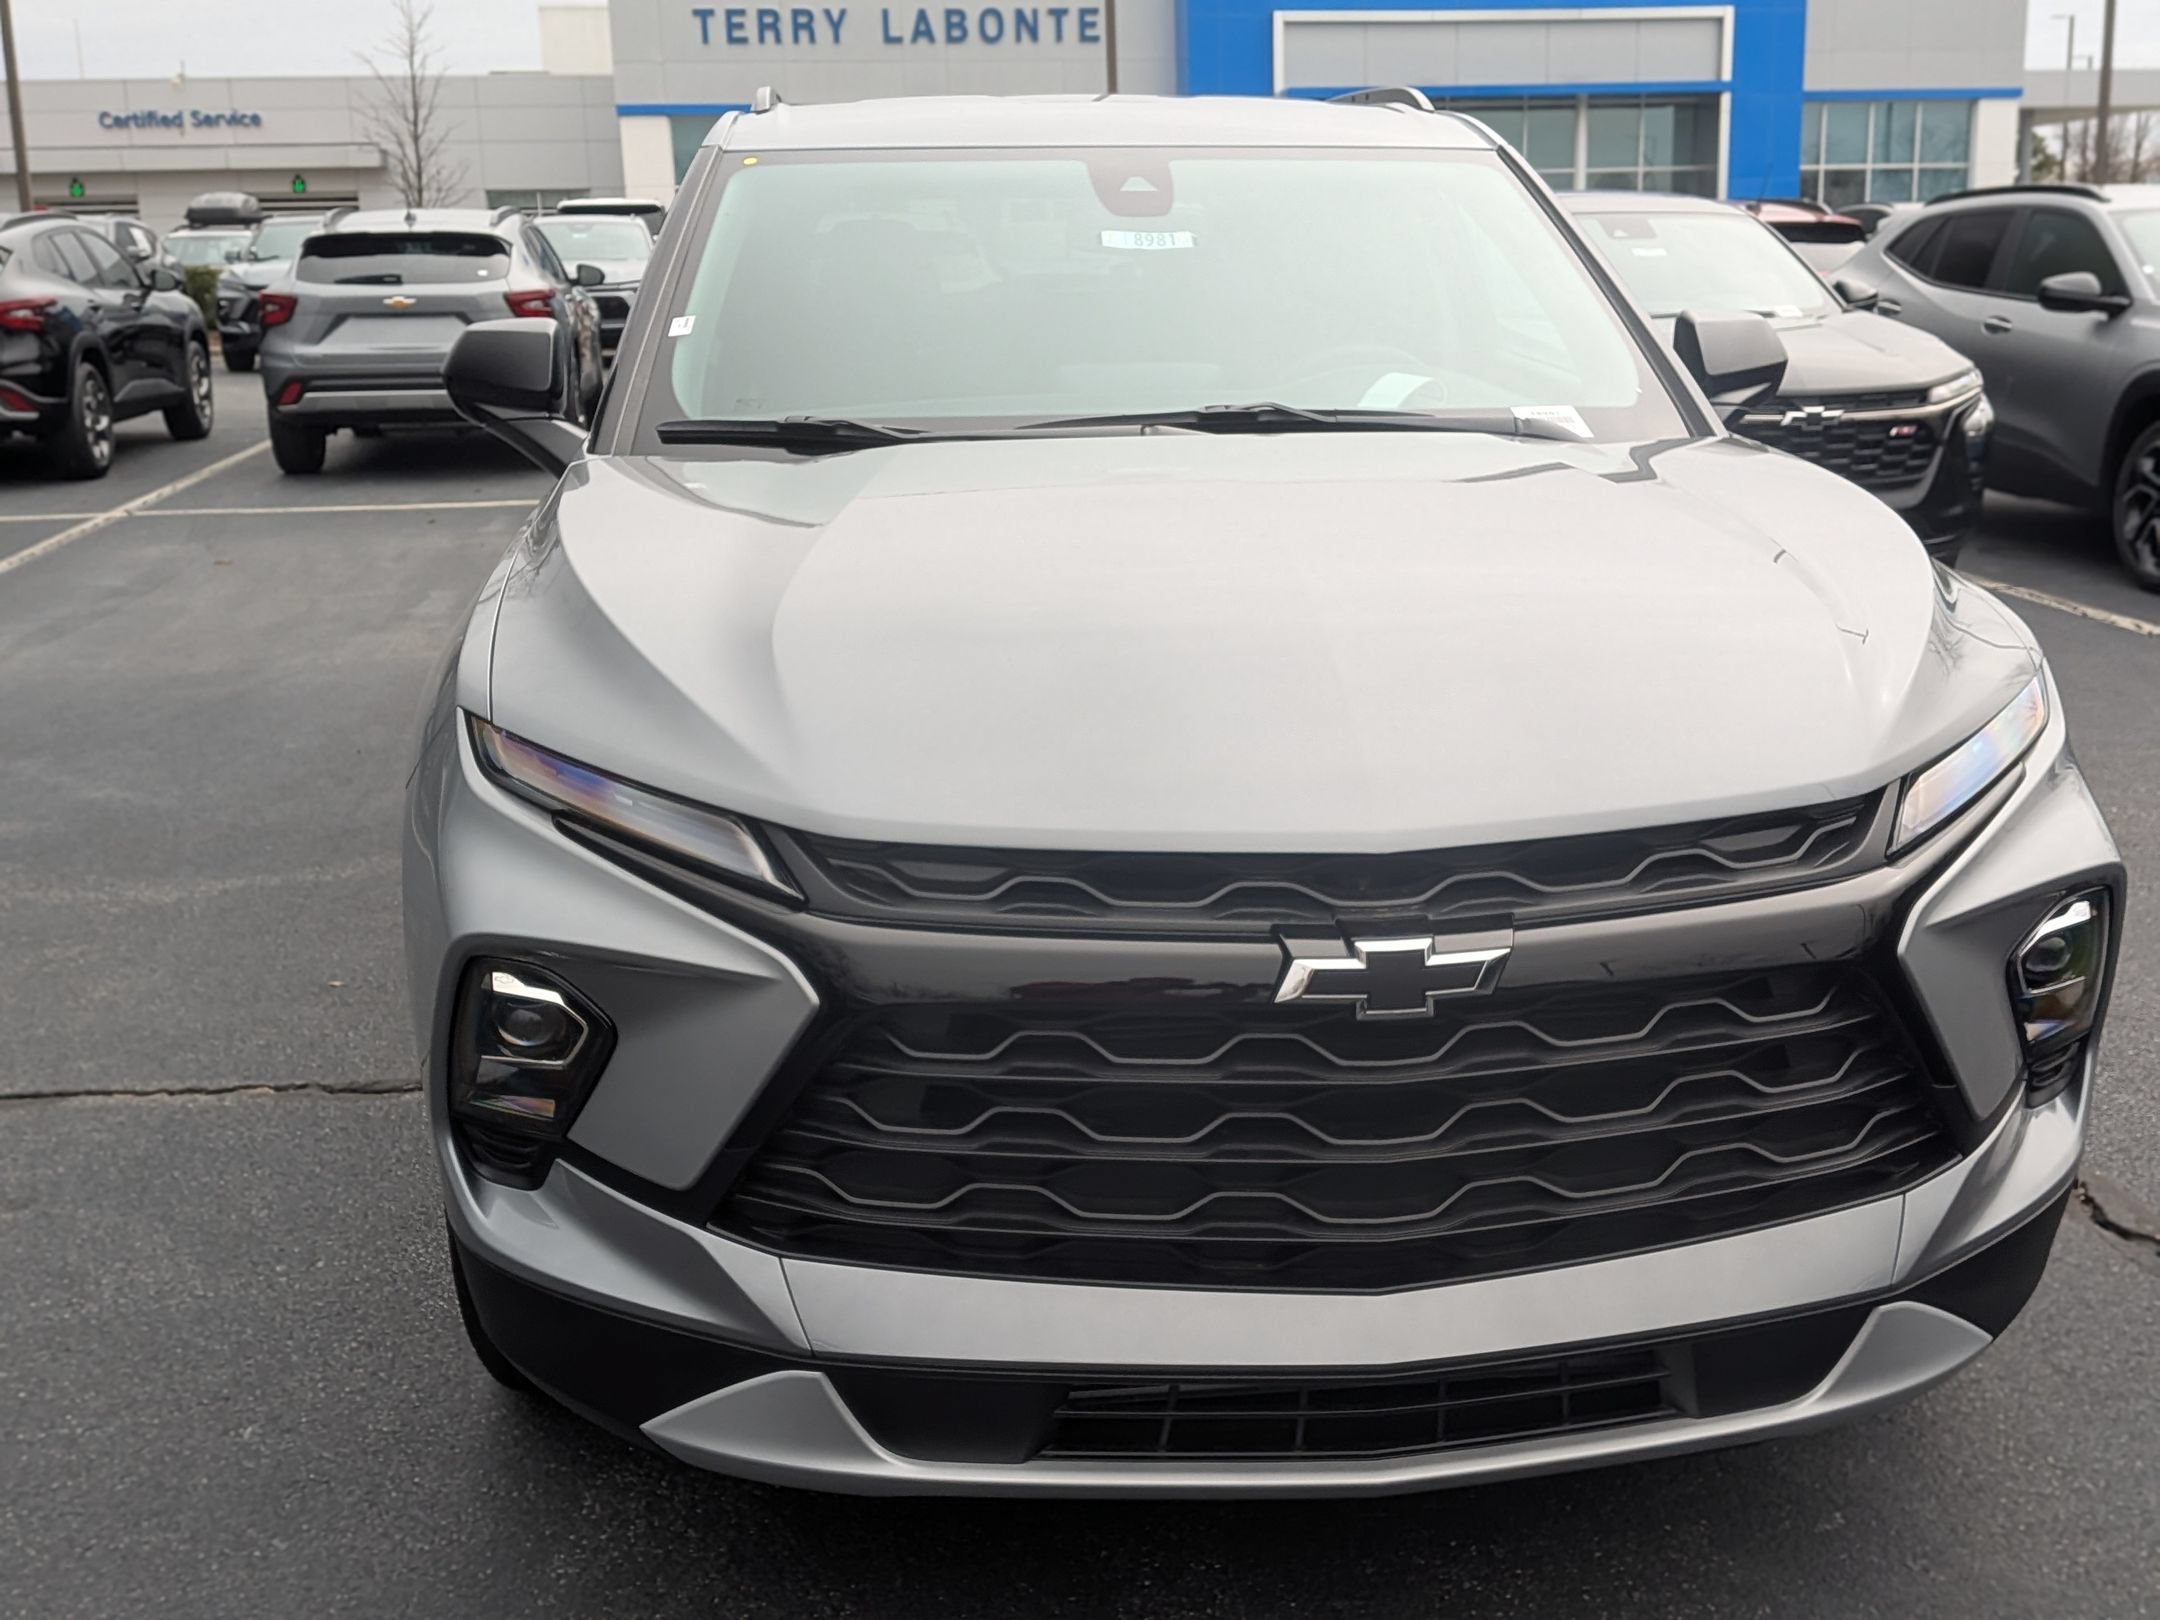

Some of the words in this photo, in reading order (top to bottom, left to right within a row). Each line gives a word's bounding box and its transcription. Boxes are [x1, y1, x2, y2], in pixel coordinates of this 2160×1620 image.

[692, 9, 847, 45] TERRY
[881, 8, 1101, 45] LABONTE
[98, 110, 184, 129] Certified
[190, 110, 262, 128] Service
